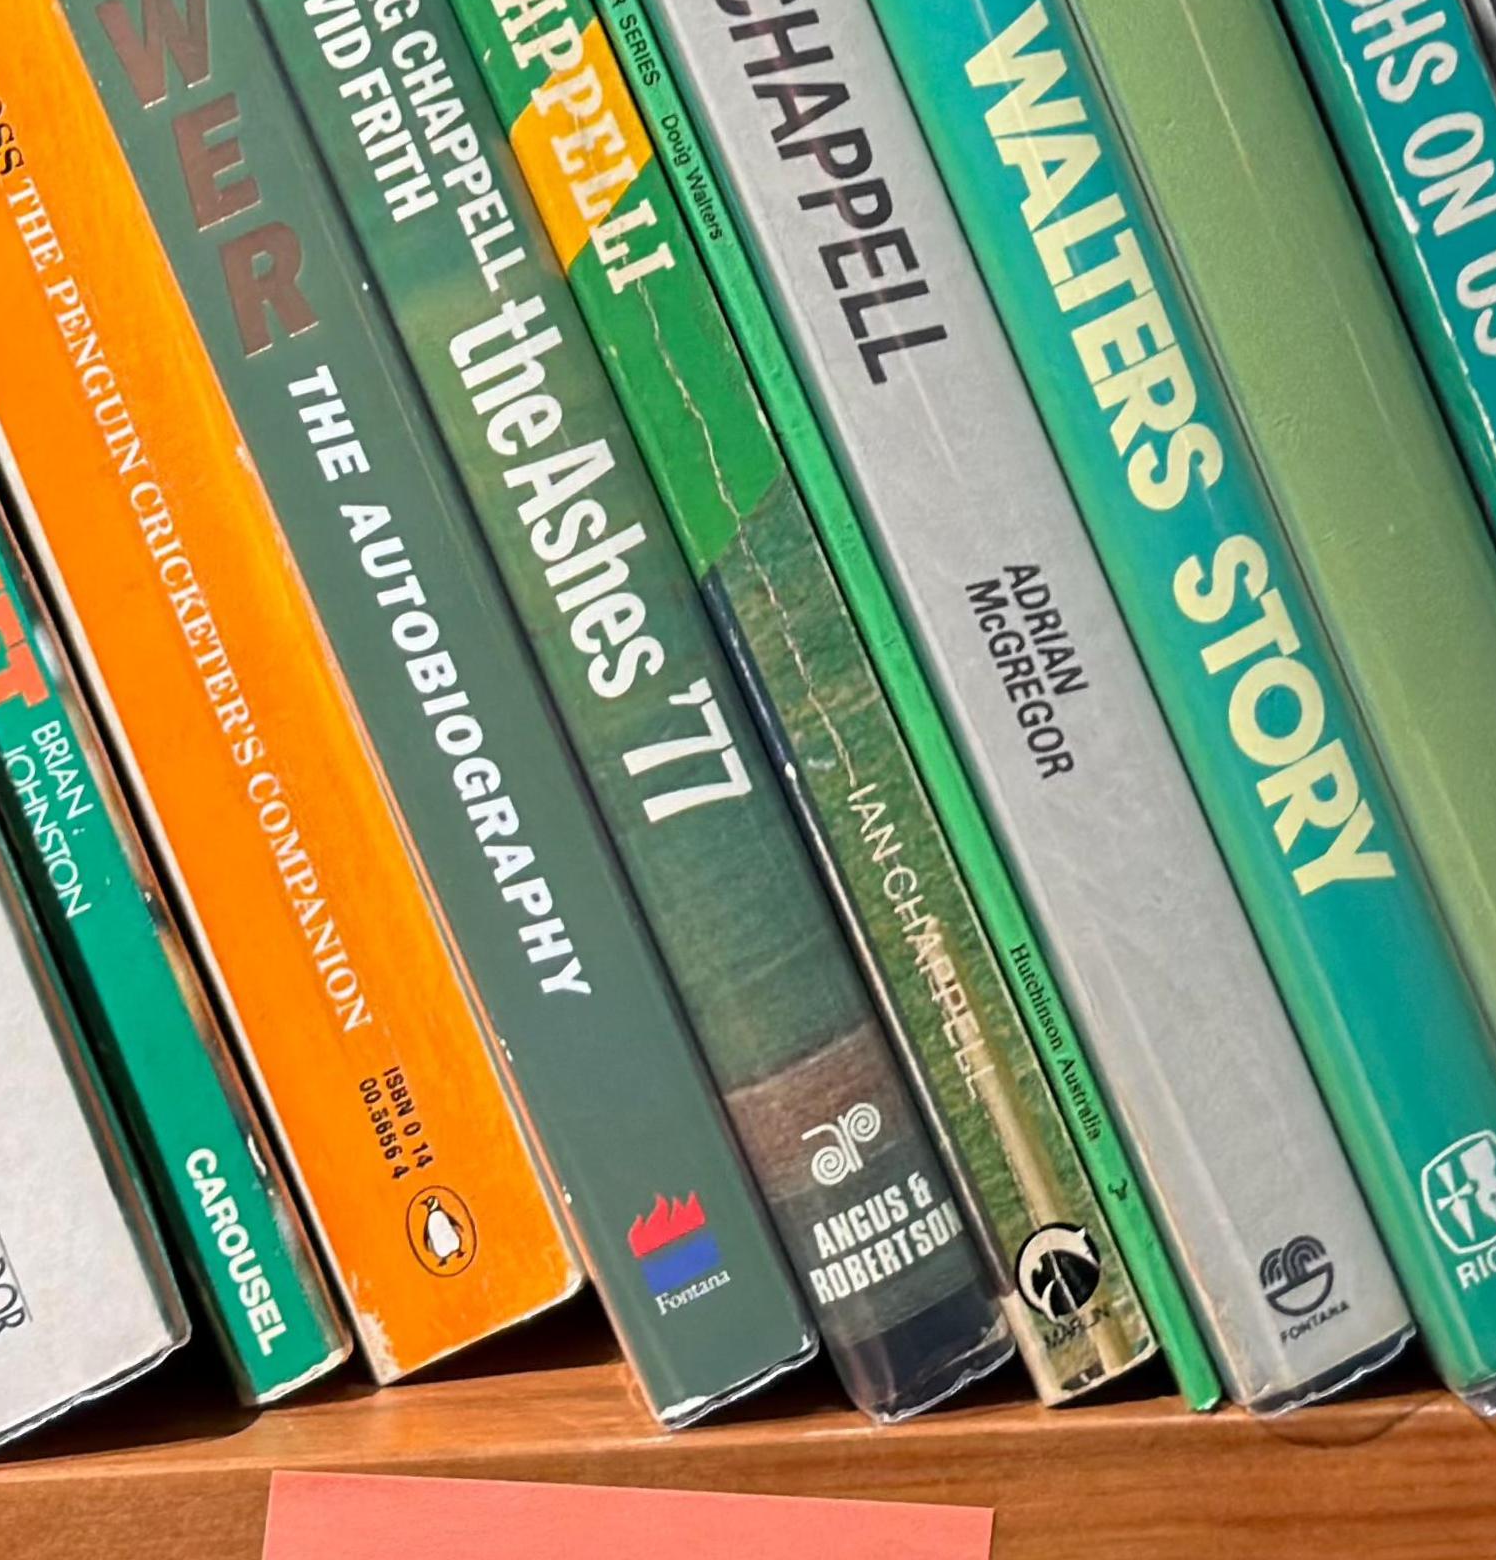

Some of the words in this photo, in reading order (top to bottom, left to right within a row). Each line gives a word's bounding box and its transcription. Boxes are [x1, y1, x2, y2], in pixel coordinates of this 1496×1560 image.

[339, 68, 438, 223] FRITH
[392, 30, 527, 291] CHAPPELL
[618, 14, 661, 88] SERIES
[661, 113, 690, 176] Doug
[687, 173, 722, 241] Walters
[448, 295, 564, 456] the
[6, 176, 66, 276] THE
[44, 275, 148, 482] PENGUIN
[128, 481, 267, 768] CRICKETER'S
[247, 771, 372, 1033] COMPANION
[502, 438, 664, 698] Ashes
[1005, 563, 1088, 698] ADRIAN
[289, 365, 371, 482] THE
[340, 502, 592, 996] AUTOBIOGRAPHY
[622, 678, 751, 823] '77
[965, 578, 1073, 780] McGREGOR
[1173, 534, 1395, 896] STORY
[3, 745, 92, 919] JOHNSTON
[31, 720, 95, 820] BRIAN
[849, 784, 903, 862] IAN
[883, 864, 993, 1100] CHAPPELL
[383, 1065, 415, 1116] ISBN
[1009, 943, 1064, 1053] Hutchinson
[1057, 1056, 1101, 1142] Australia
[392, 1163, 409, 1180] 4
[405, 1121, 421, 1137] 0
[412, 1142, 433, 1168] 14
[184, 1147, 294, 1357] CAROUSEL
[655, 1267, 731, 1316] Fontana
[810, 1201, 962, 1304] ROBERTSON
[813, 1191, 903, 1259] ANGUS
[911, 1173, 933, 1203] &
[1280, 1300, 1349, 1343] FONTANA
